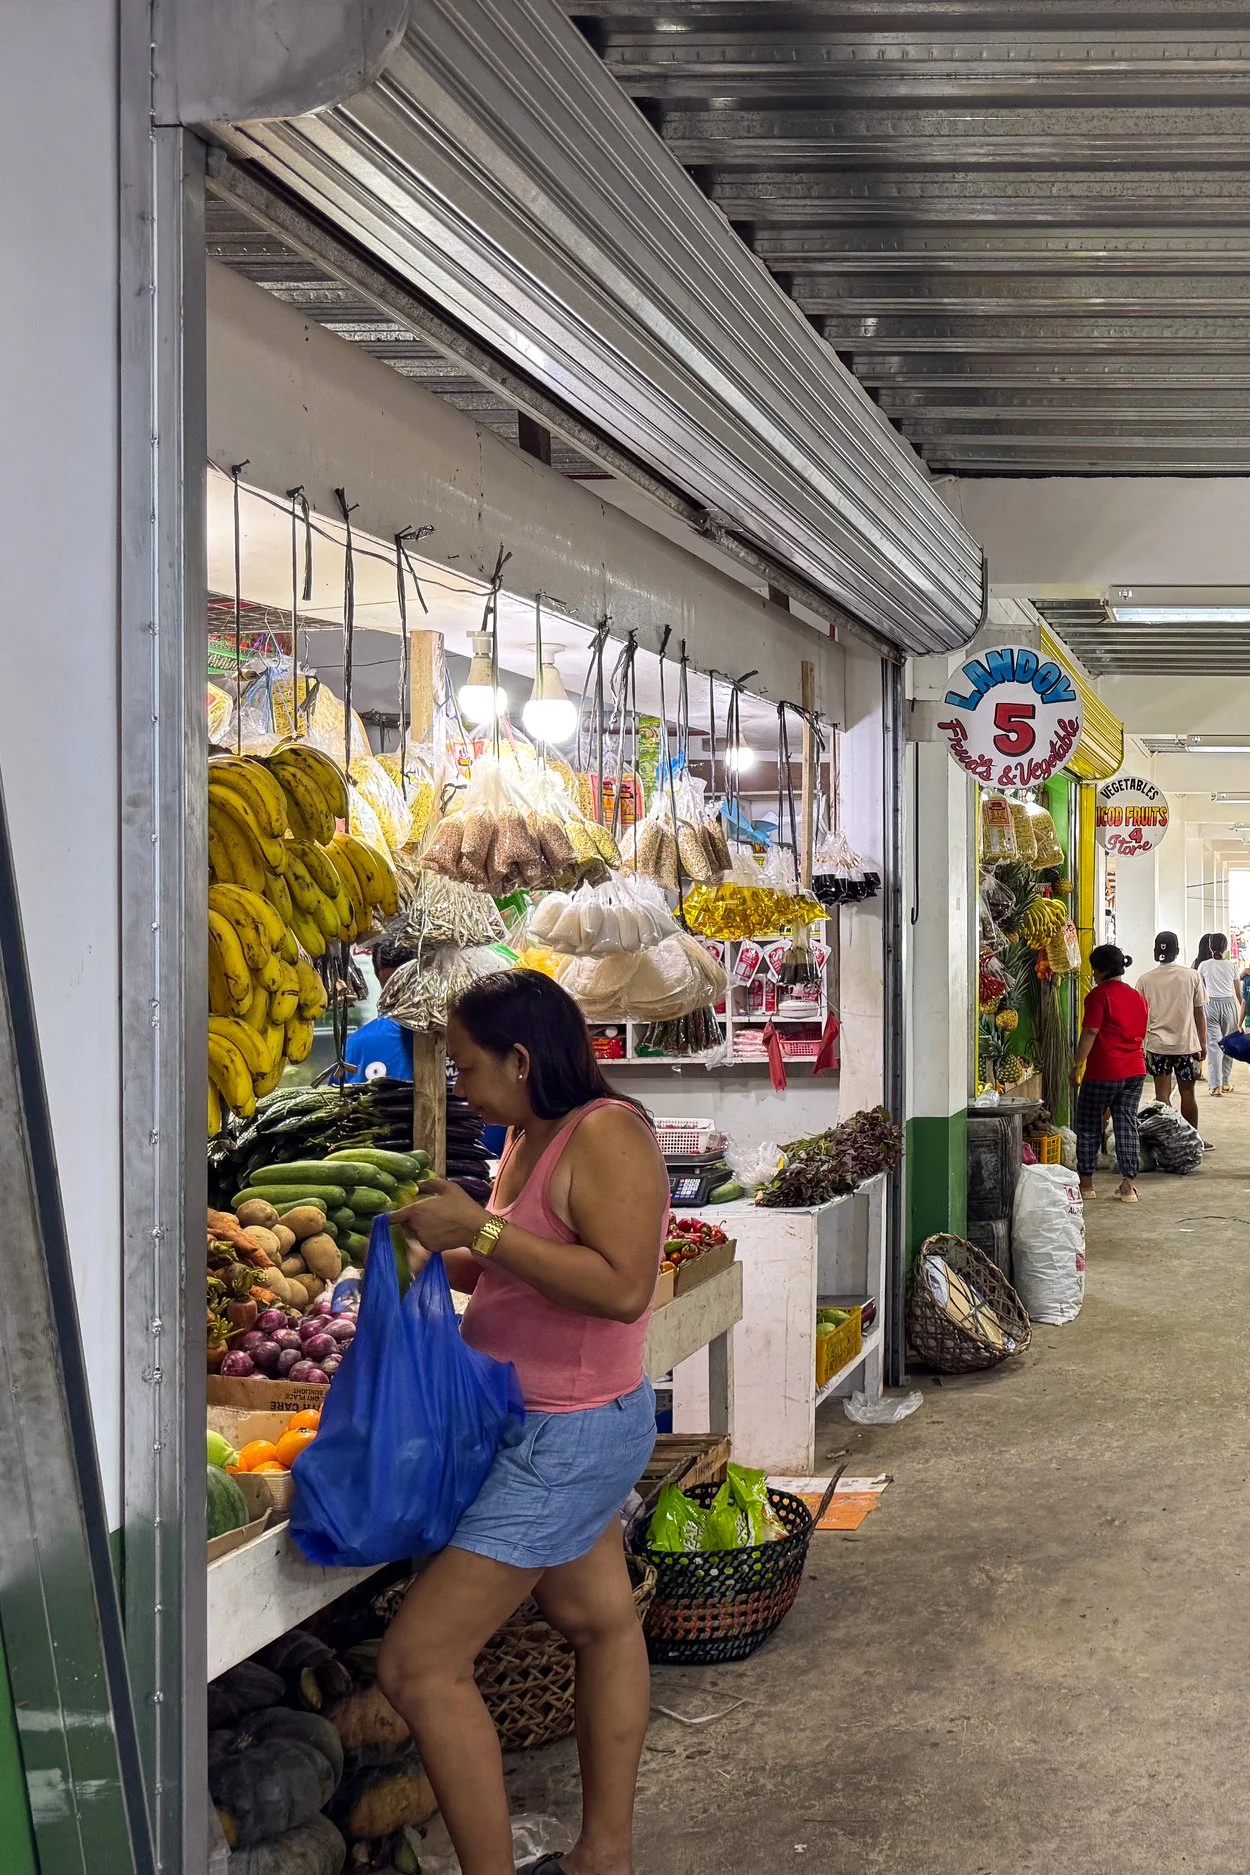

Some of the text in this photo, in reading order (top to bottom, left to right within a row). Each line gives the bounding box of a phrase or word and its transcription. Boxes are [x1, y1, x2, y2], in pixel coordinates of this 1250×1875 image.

[945, 648, 1076, 711] LANDOY
[993, 702, 1036, 757] 5
[998, 765, 1017, 787] &
[1015, 716, 1080, 786] Vegetable
[1100, 778, 1159, 800] VEGETABLES
[1125, 806, 1168, 827] FRUITS
[1105, 834, 1153, 856] Store
[1128, 827, 1143, 843] 4
